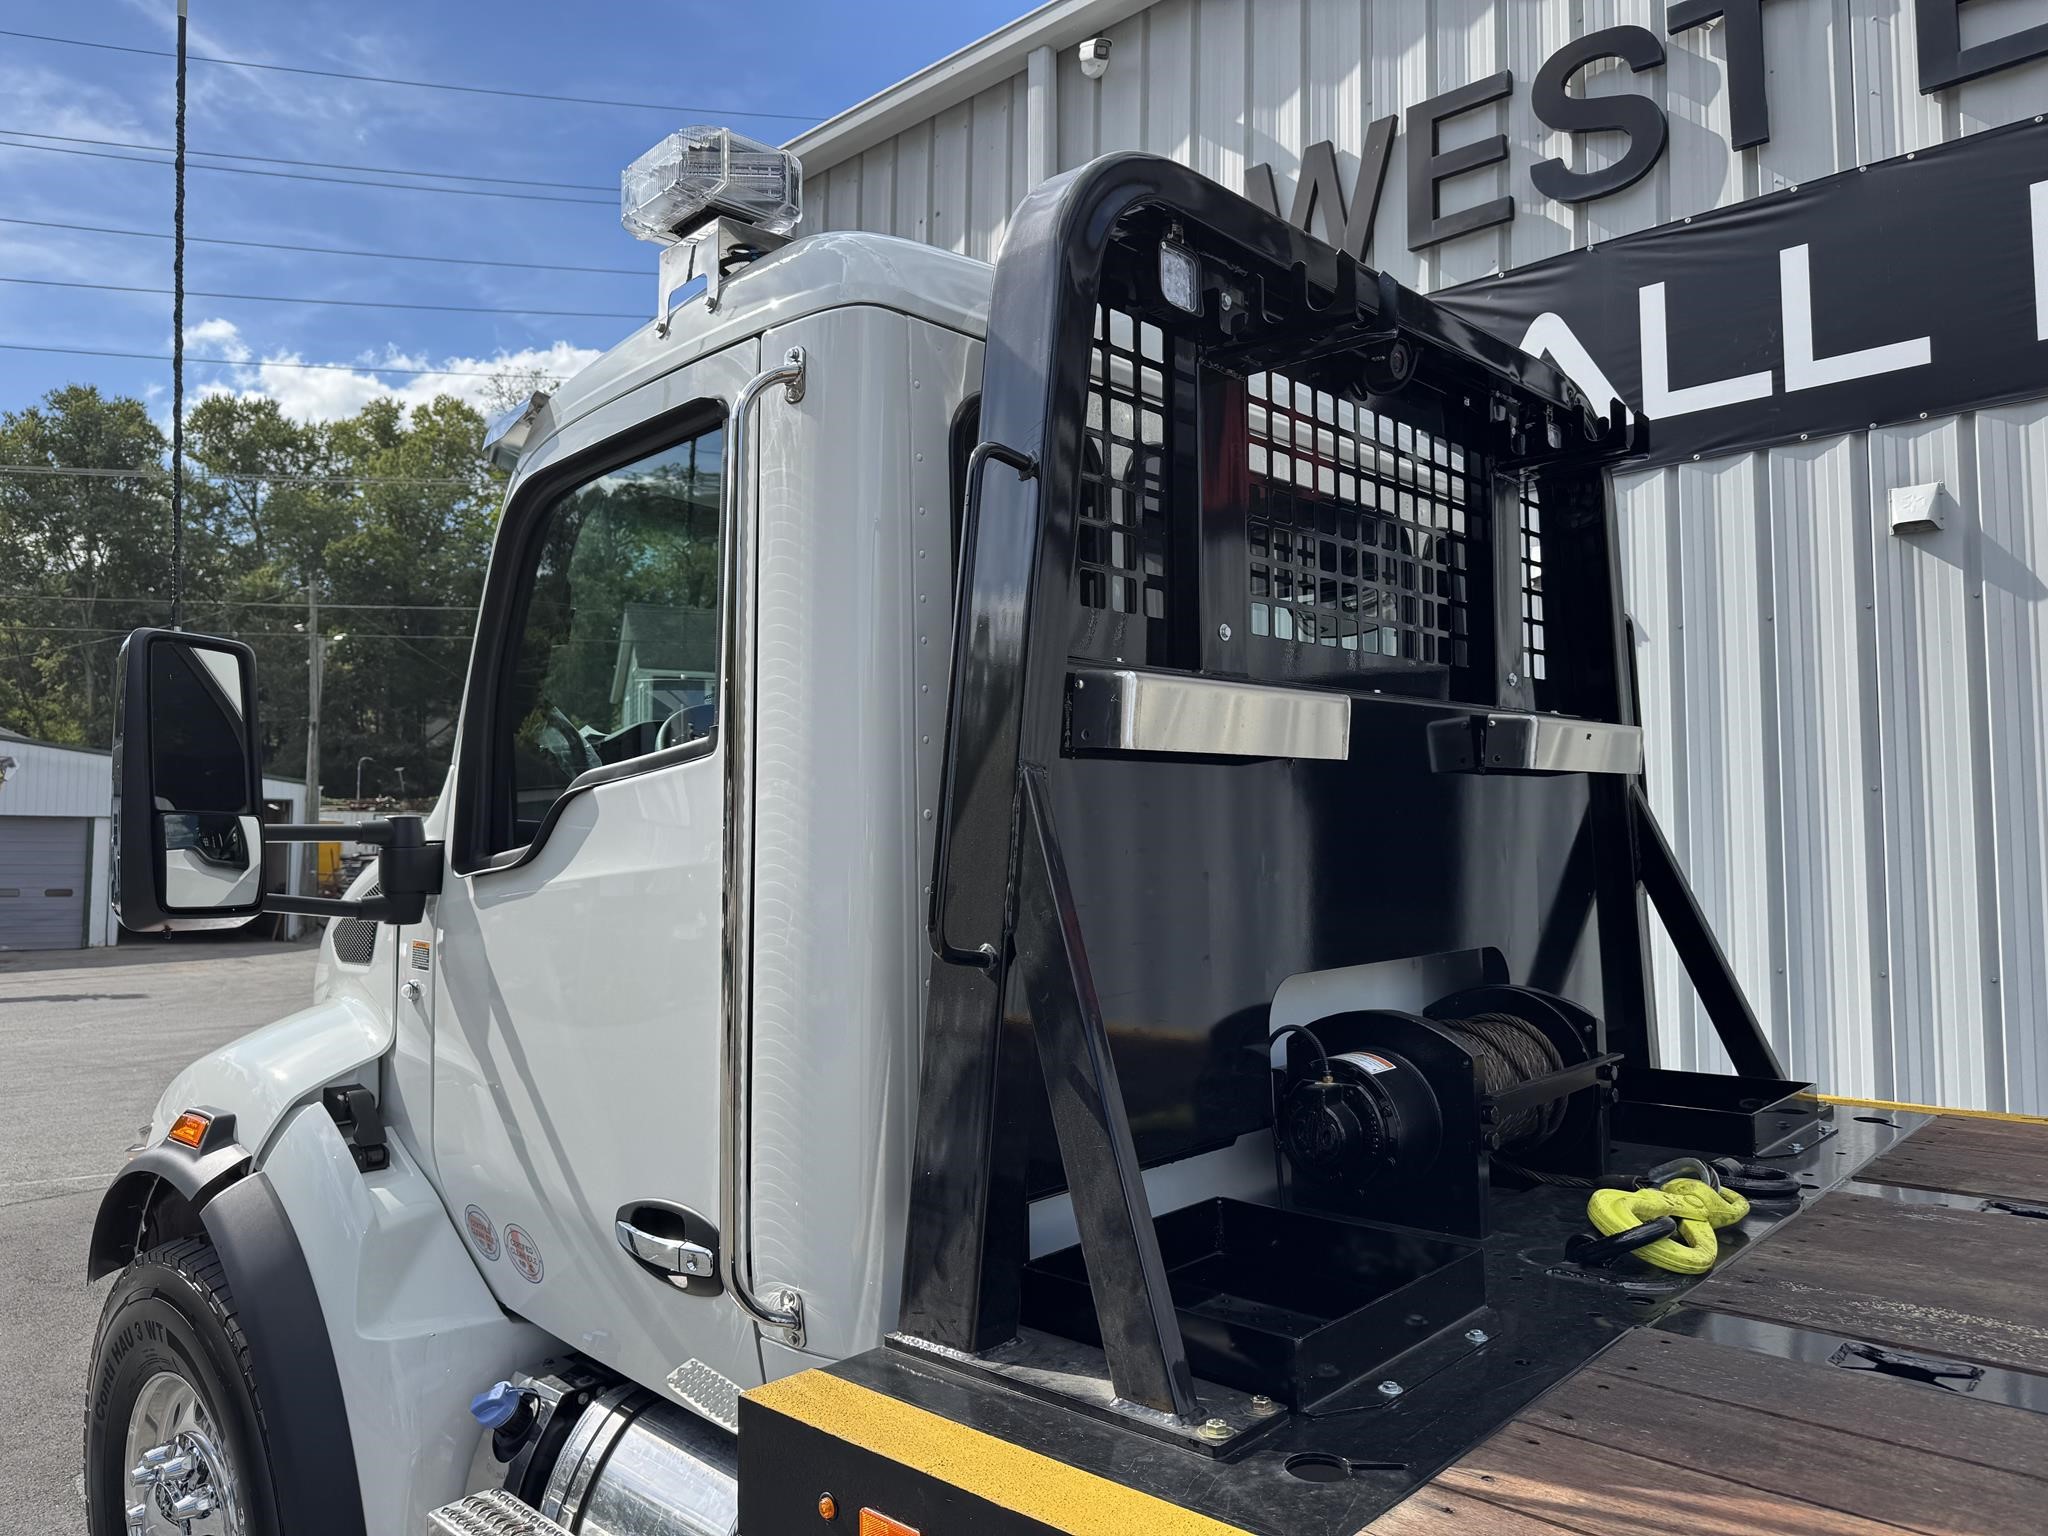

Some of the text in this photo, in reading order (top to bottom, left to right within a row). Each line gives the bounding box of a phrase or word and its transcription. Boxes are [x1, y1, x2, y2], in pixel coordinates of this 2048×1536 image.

[1519, 243, 1931, 426] ALL
[134, 1321, 143, 1342] 3
[144, 1319, 164, 1343] WT
